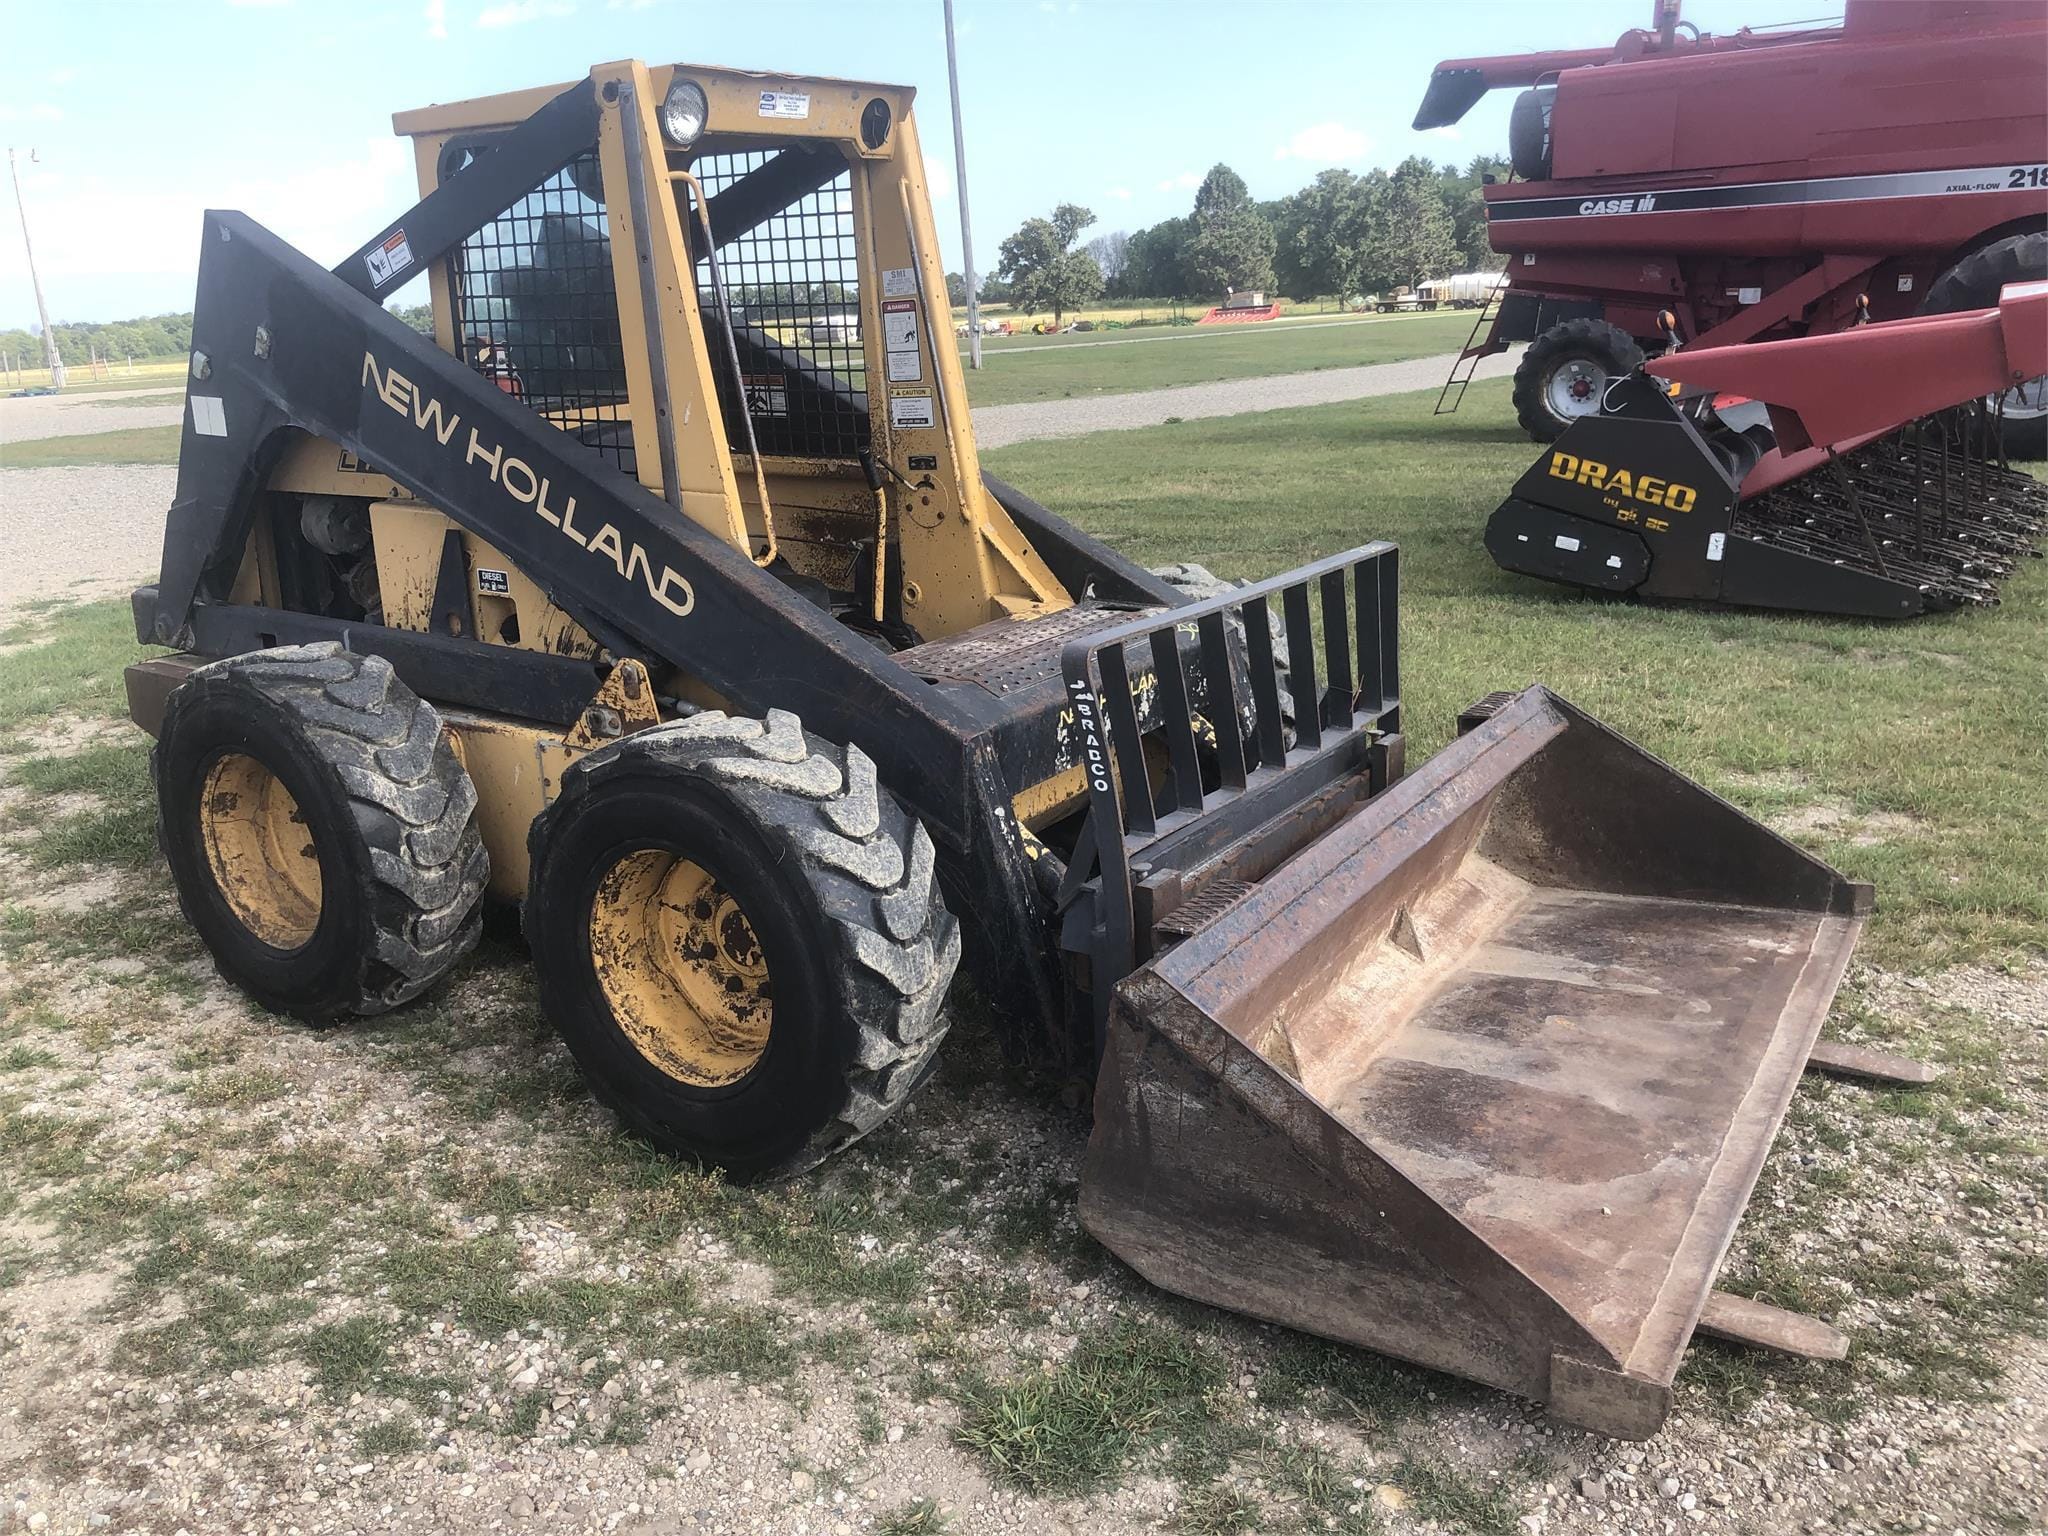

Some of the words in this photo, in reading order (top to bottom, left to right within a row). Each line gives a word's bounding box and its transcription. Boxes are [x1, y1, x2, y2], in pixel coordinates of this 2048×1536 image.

[1579, 199, 1634, 215] CASE
[1946, 183, 2000, 192] AXIAL-FLOW
[362, 351, 460, 446] NEW
[465, 427, 695, 617] HOLLAND
[1549, 451, 1697, 513] DRAGO
[481, 571, 504, 582] DIESEL
[1077, 703, 1109, 792] BRADCO
